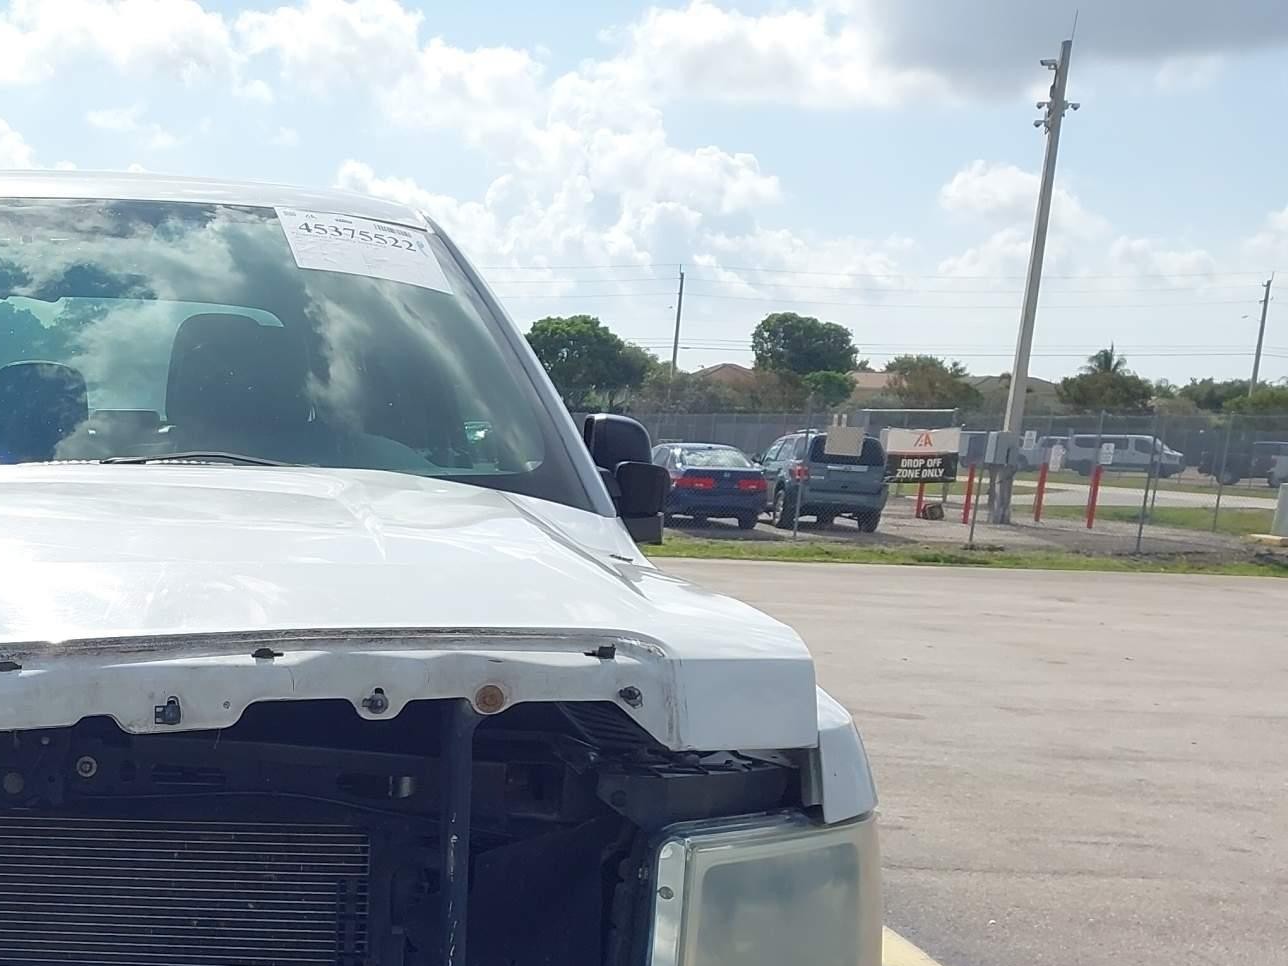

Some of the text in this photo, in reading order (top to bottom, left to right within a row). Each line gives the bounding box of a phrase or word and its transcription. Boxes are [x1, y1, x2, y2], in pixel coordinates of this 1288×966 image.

[299, 222, 416, 252] 45375522
[901, 458, 942, 468] DROP OFF
[896, 468, 945, 478] ZONE ONLY
